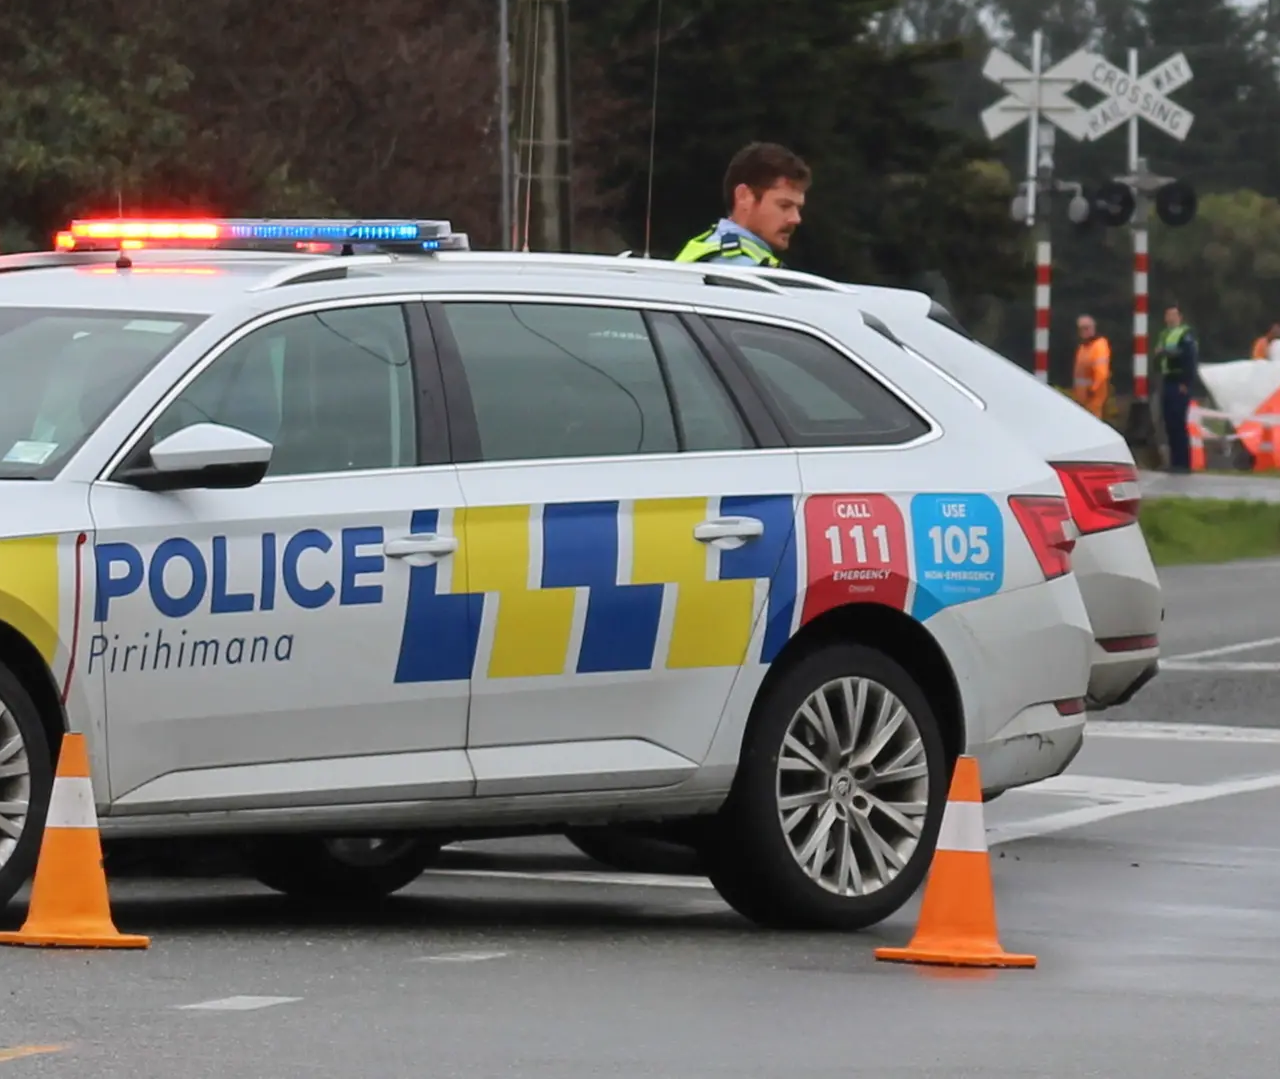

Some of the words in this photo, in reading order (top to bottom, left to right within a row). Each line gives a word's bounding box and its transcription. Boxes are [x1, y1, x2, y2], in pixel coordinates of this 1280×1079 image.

[1091, 62, 1186, 131] CROSSING
[836, 503, 872, 518] CALL
[941, 503, 968, 518] USE
[824, 524, 891, 565] 111
[927, 524, 991, 565] 105
[93, 525, 386, 622] POLICE
[832, 569, 892, 581] EMERGENCY
[923, 570, 996, 582] NON-EMERGENCY
[87, 628, 295, 675] Pirihimana
